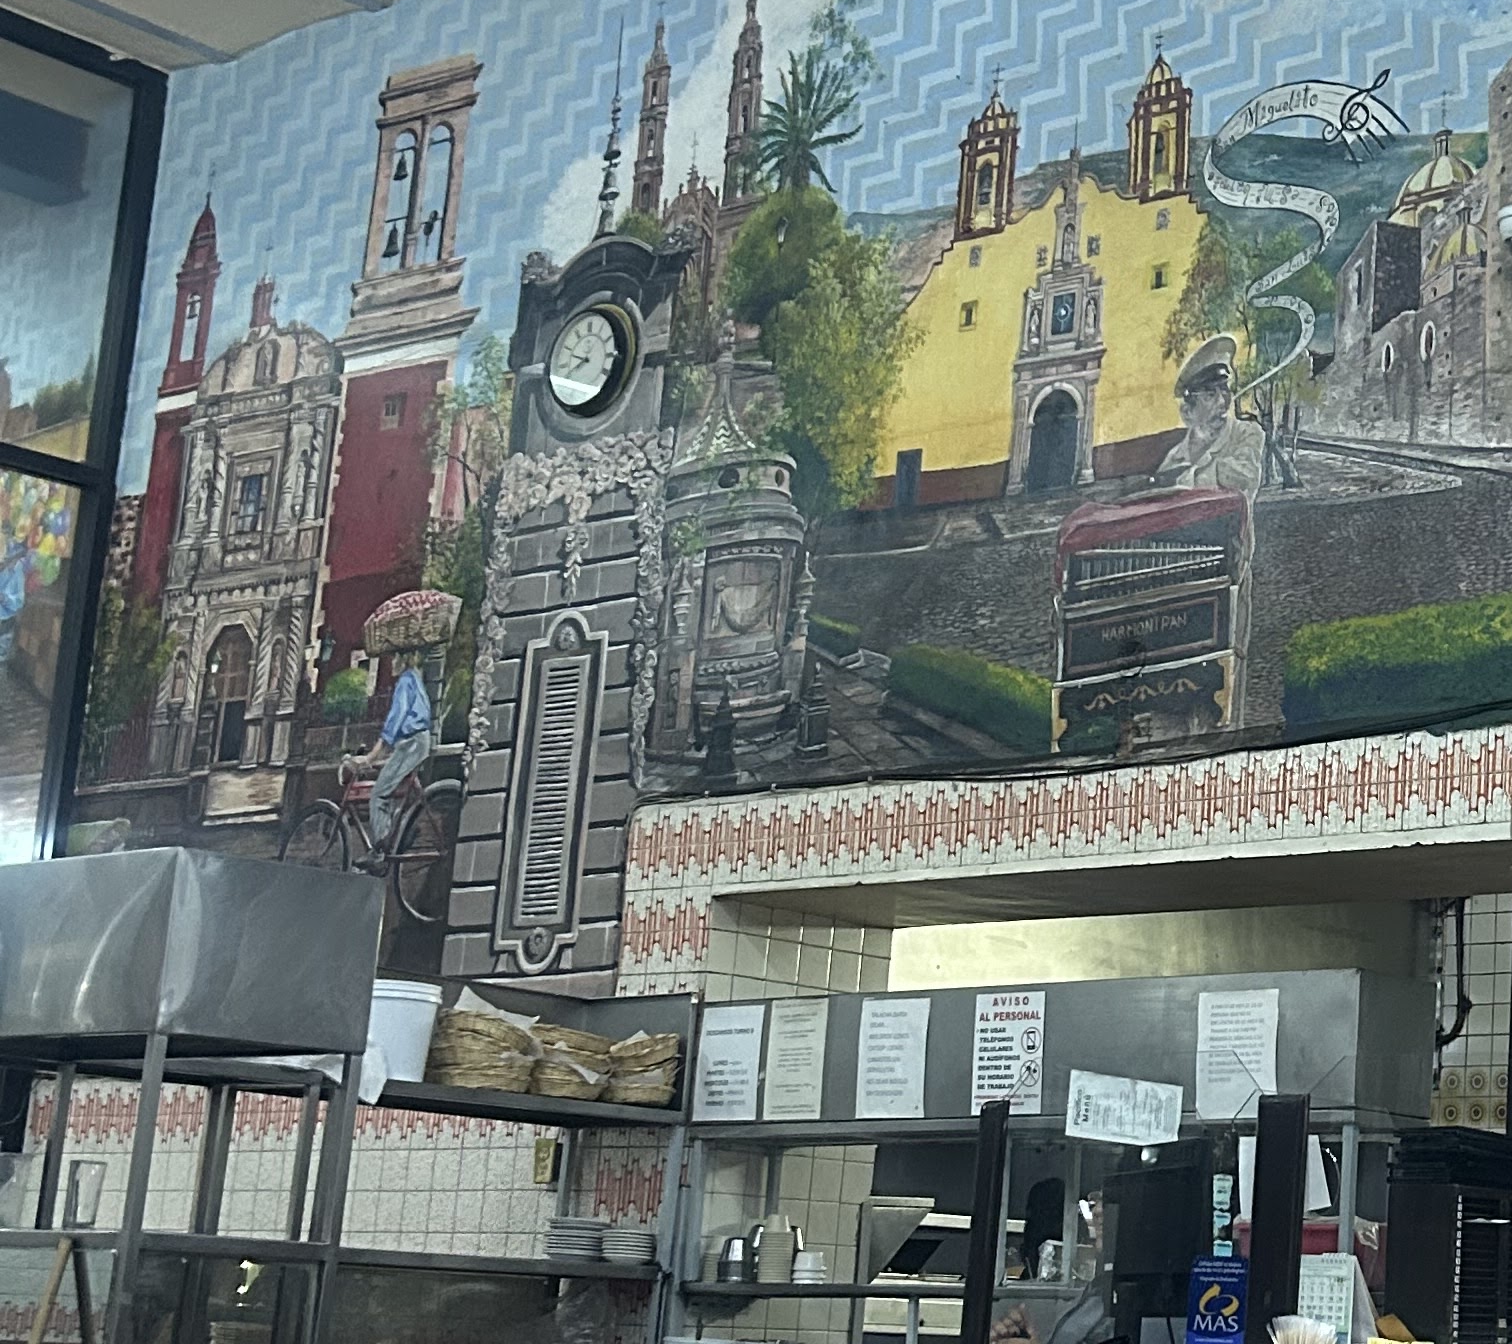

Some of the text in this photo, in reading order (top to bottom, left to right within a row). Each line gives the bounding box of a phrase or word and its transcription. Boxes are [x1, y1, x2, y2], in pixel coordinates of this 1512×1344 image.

[1240, 84, 1319, 134] Miguelito
[992, 996, 1030, 1007] AVISO
[979, 1010, 1042, 1022] AL PERSONAL
[1193, 1314, 1240, 1333] MAS
